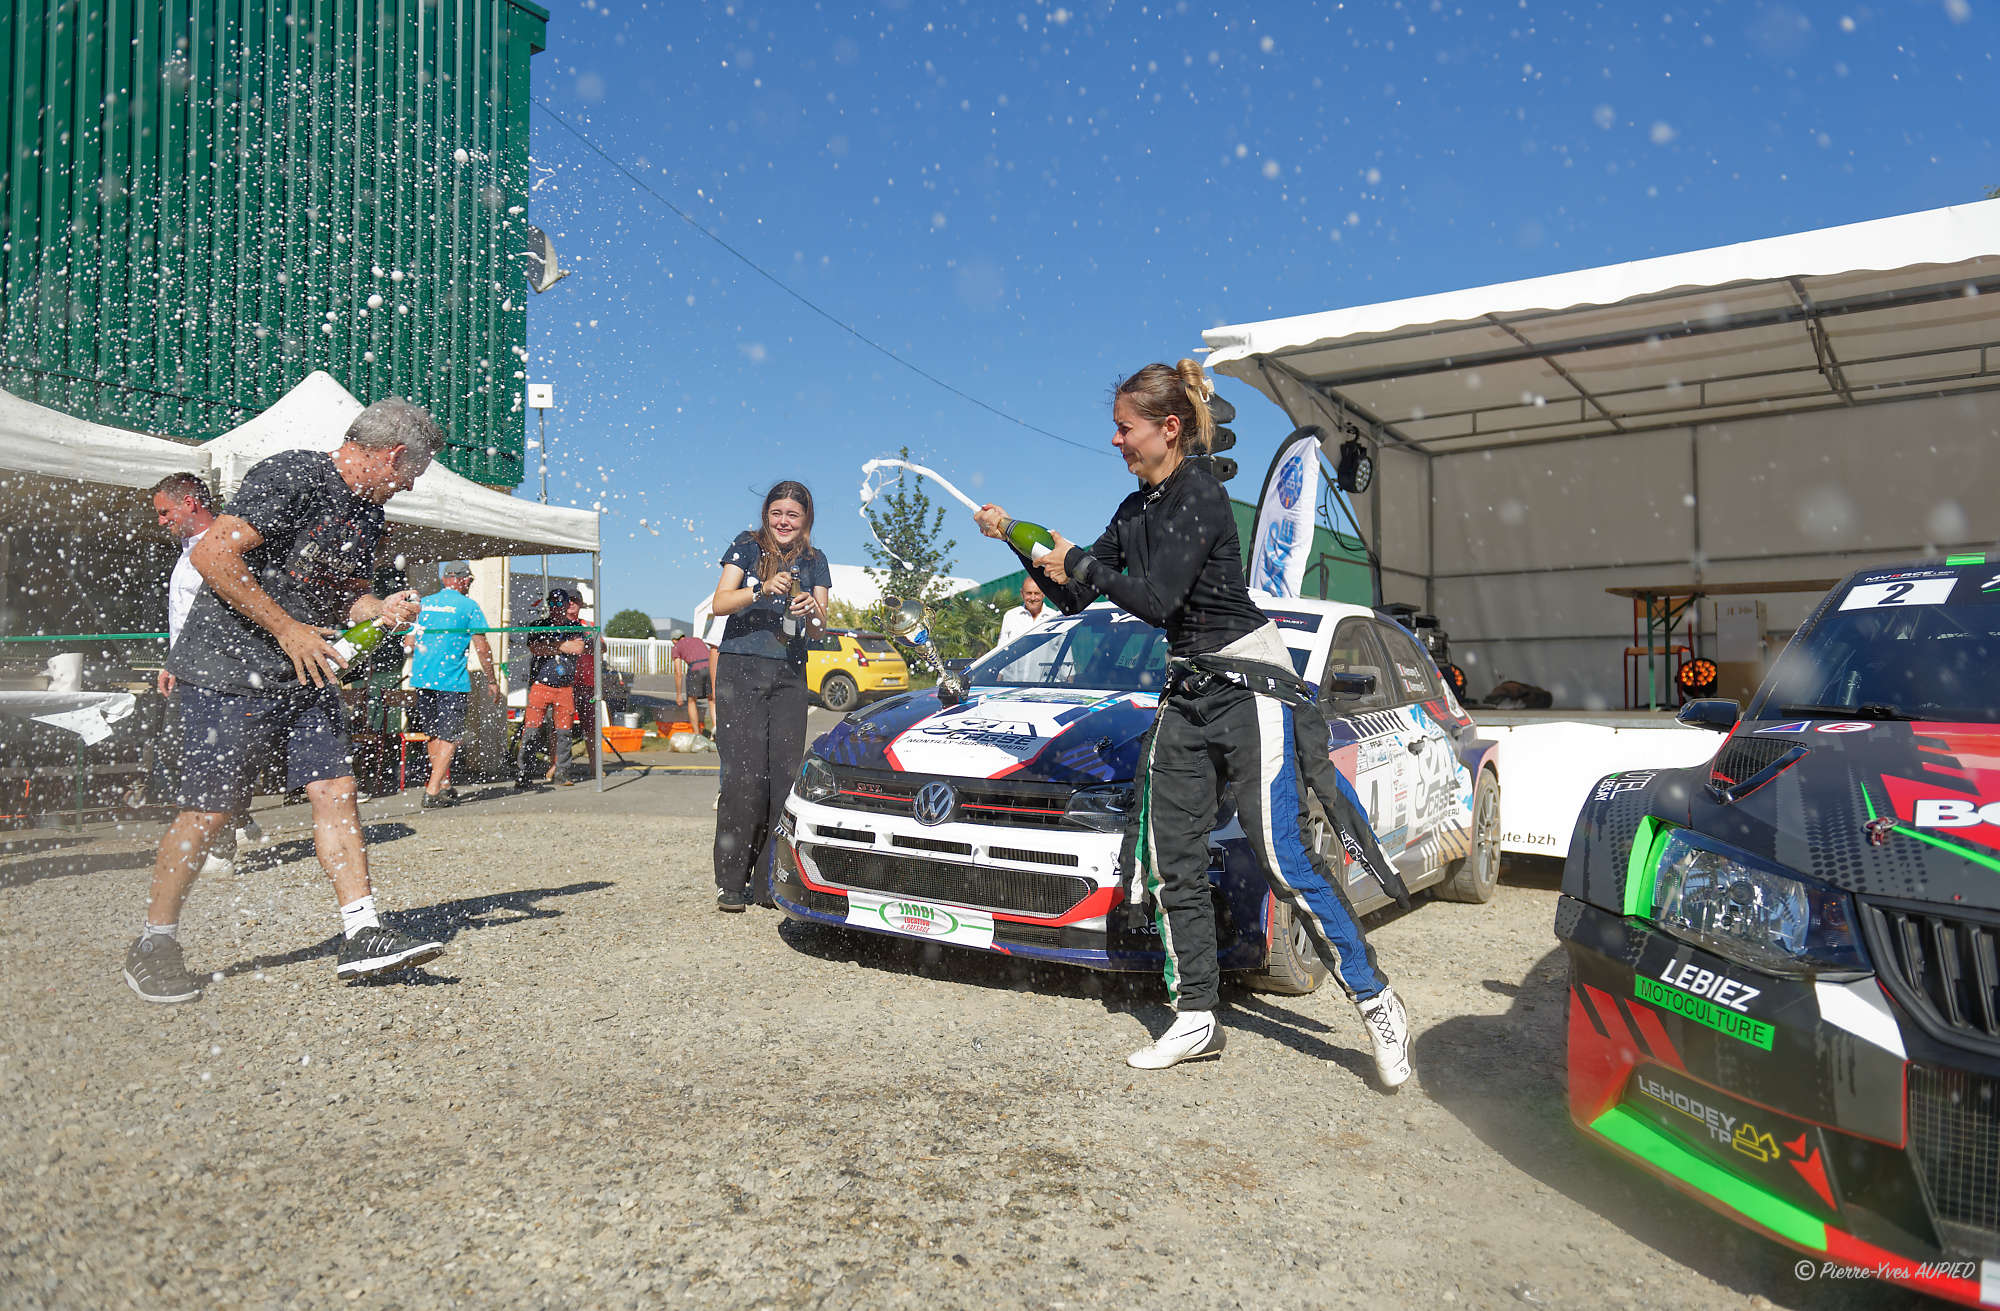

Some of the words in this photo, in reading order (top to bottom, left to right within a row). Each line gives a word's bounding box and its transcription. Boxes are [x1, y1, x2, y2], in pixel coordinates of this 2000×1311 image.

[1878, 583, 1915, 605] 2
[947, 732, 1033, 746] CASSE
[856, 782, 882, 793] GTI
[1609, 769, 1657, 800] OTEL
[1368, 780, 1380, 831] 4
[898, 902, 935, 920] JARDI
[1660, 958, 1761, 1013] LEBIEZ
[1640, 979, 1766, 1045] MOTOCULTURE
[1638, 1074, 1737, 1133] LEHODEY
[1706, 1122, 1732, 1144] TP
